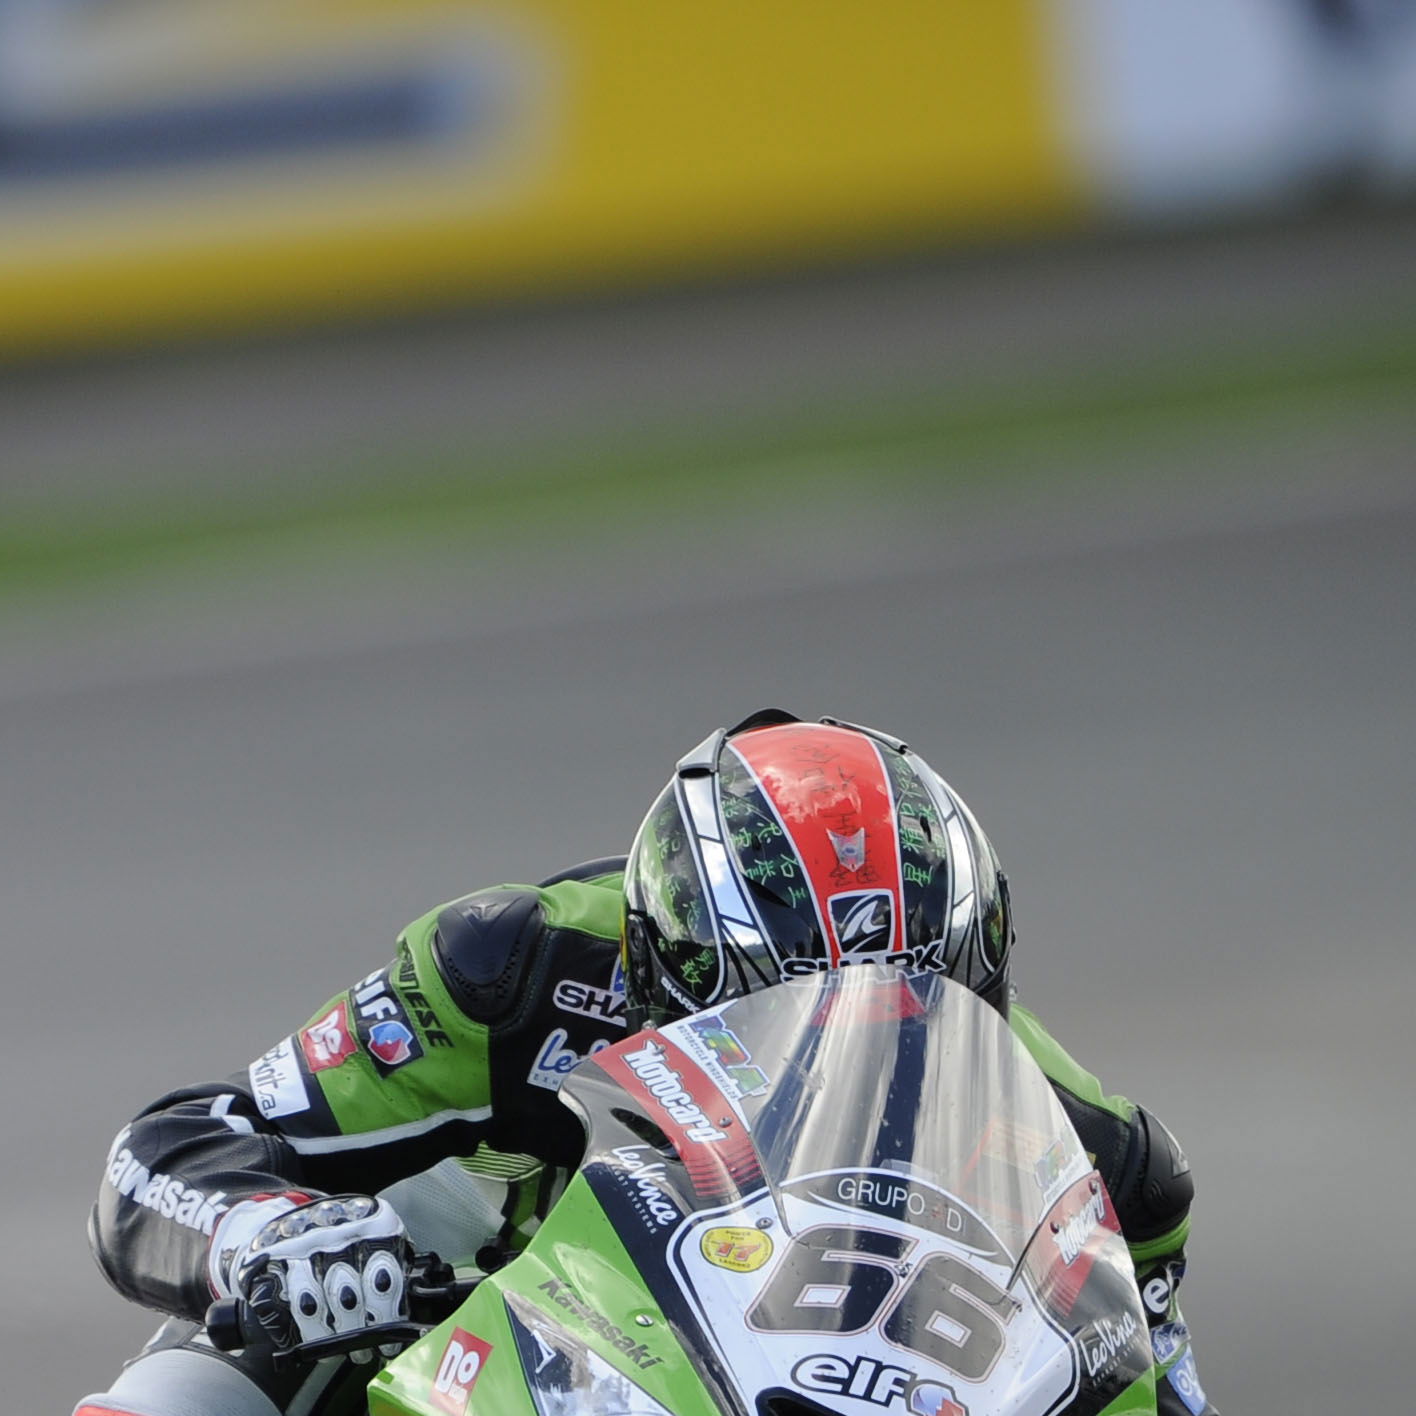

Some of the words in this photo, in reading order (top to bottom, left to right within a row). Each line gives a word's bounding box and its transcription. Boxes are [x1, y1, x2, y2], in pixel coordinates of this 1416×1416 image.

[557, 984, 626, 1018] SHA
[106, 1123, 230, 1236] awasak
[837, 1178, 926, 1216] GRUPO
[538, 1279, 664, 1370] Kawasaki
[745, 1225, 1021, 1384] 66
[791, 1353, 920, 1408] elf
